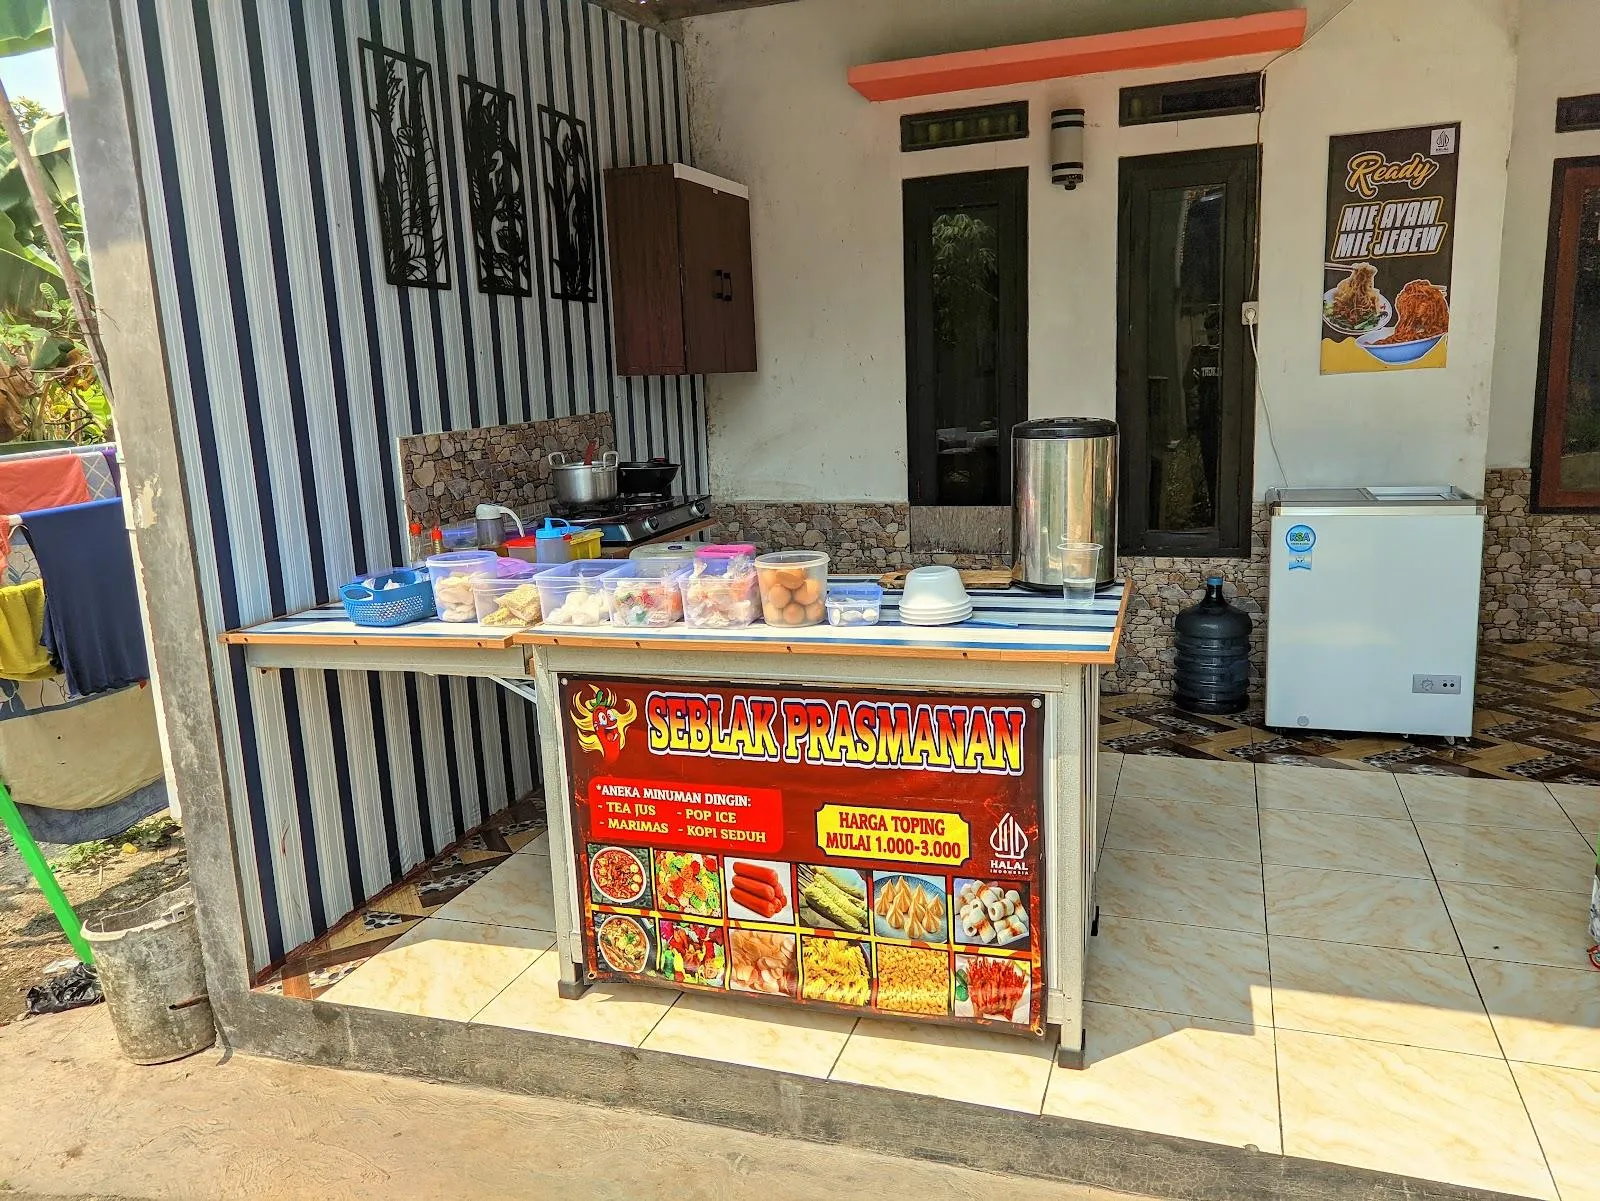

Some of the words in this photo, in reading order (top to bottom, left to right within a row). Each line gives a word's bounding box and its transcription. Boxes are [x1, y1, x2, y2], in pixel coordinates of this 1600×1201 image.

[1347, 153, 1437, 197] Ready
[1341, 205, 1380, 231] MIE
[1380, 200, 1439, 229] AYAM
[1335, 232, 1373, 258] MIE
[1373, 226, 1444, 255] JEBEW
[1289, 532, 1311, 542] RSA
[647, 692, 780, 760] SEBLAK
[783, 698, 1025, 775] PRASMANAN
[643, 788, 702, 804] MINUMAN
[704, 793, 752, 807] DINGIN:
[606, 801, 632, 814] TEA
[634, 803, 656, 817] JUS
[685, 808, 712, 822] POP
[715, 811, 737, 824] ICE
[608, 818, 669, 834] MARIMAS
[838, 811, 888, 832] HARGA
[891, 815, 945, 836] TOPING
[687, 825, 717, 839] KOPI
[721, 830, 767, 843] SEDUH
[825, 832, 872, 852] MULAI
[875, 837, 961, 859] 1.000-3.000
[990, 860, 1029, 870] HALAL
